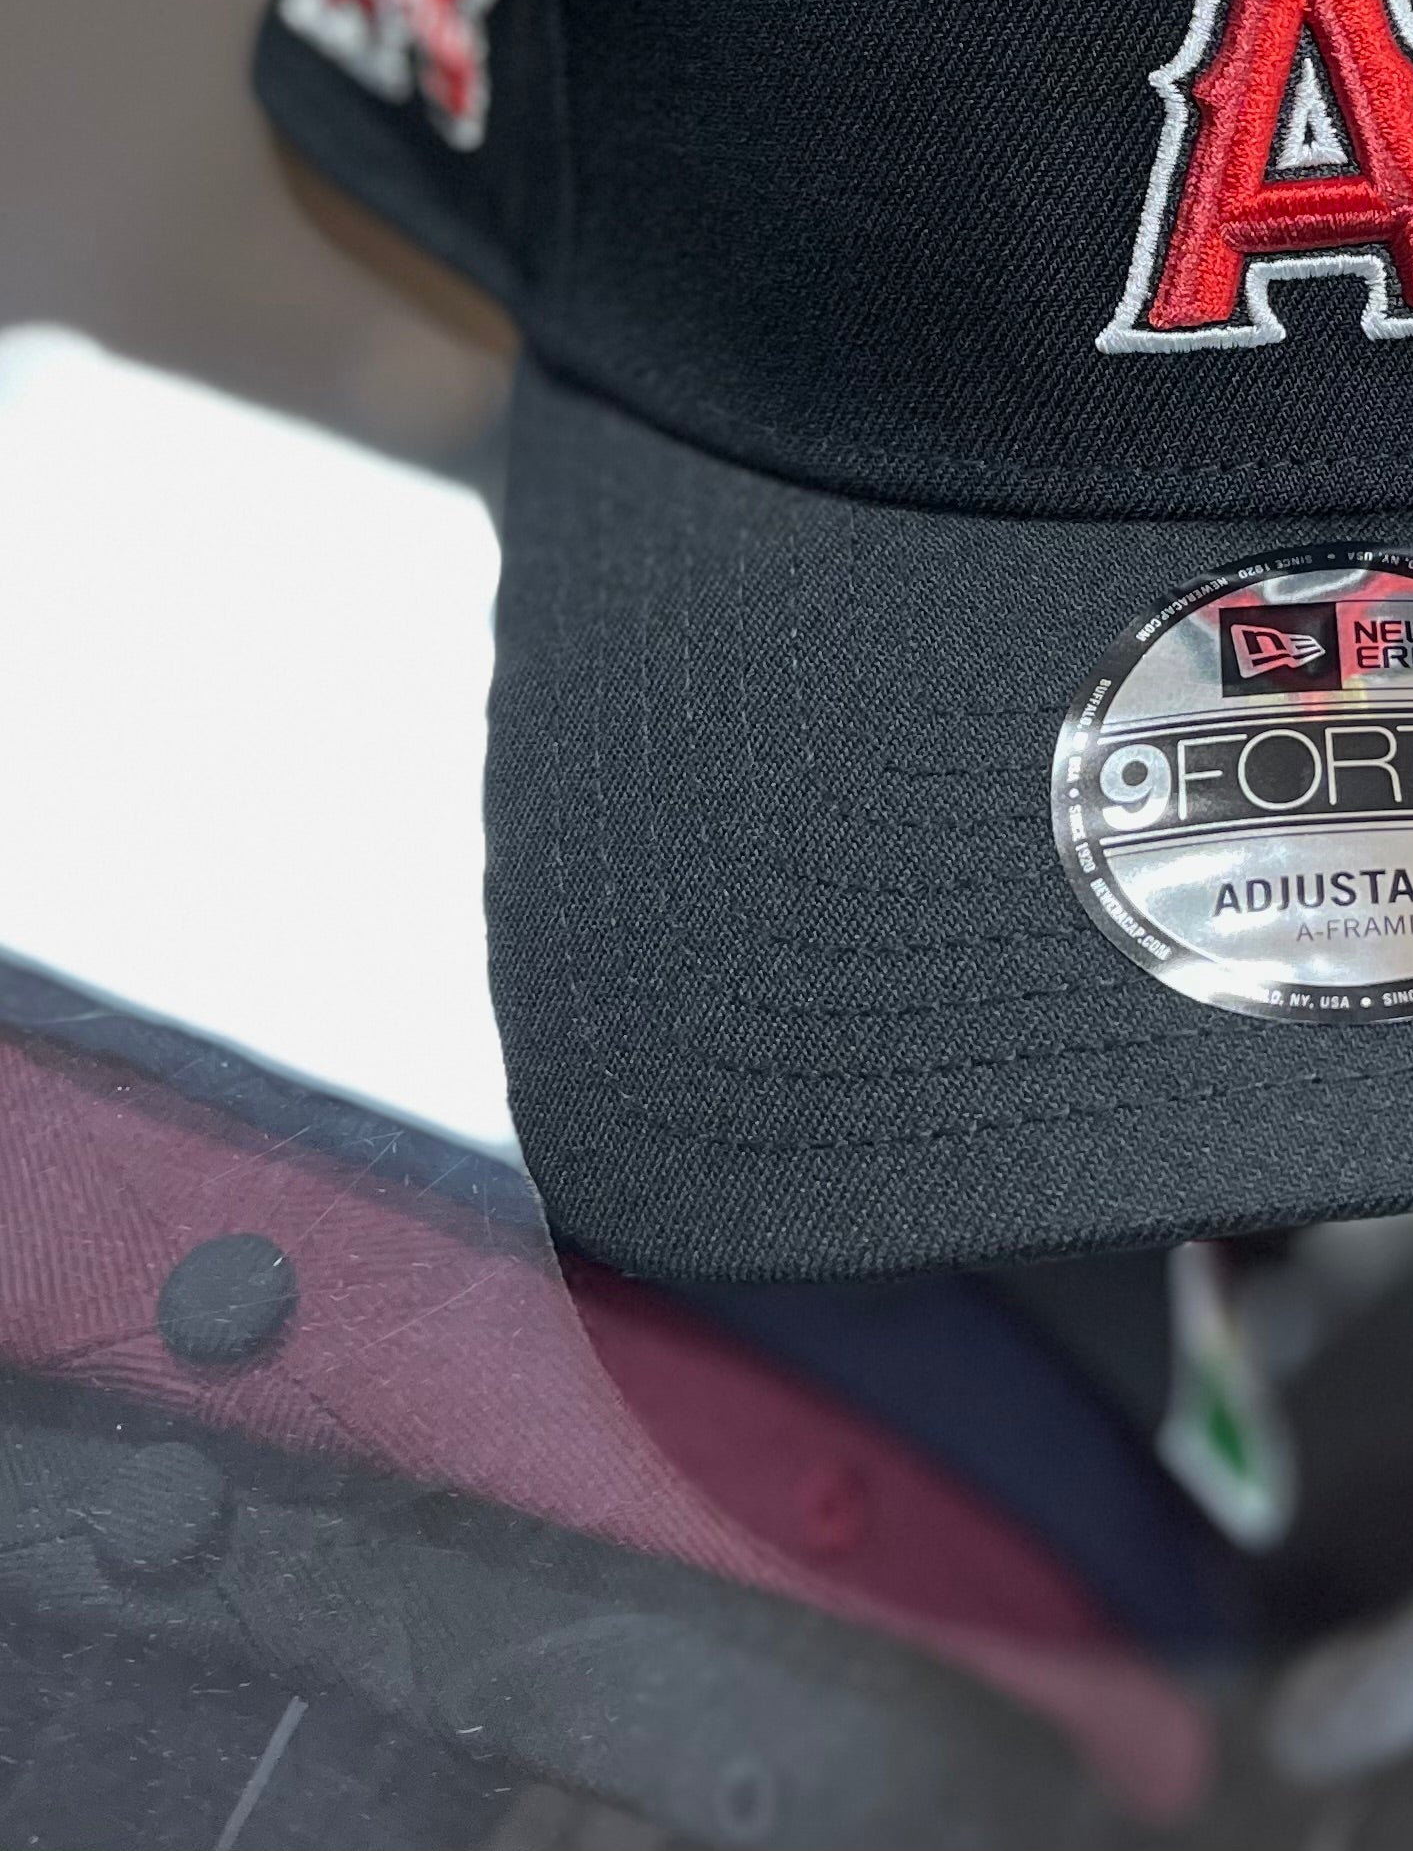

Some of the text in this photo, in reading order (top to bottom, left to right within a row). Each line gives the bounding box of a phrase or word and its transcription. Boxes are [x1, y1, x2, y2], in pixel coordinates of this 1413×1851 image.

[1274, 554, 1313, 569] SINCE
[1237, 562, 1271, 580] 1920
[1135, 576, 1229, 643] NEWERACAP.COM
[1075, 842, 1097, 874] 1920
[1319, 995, 1351, 1010] USA
